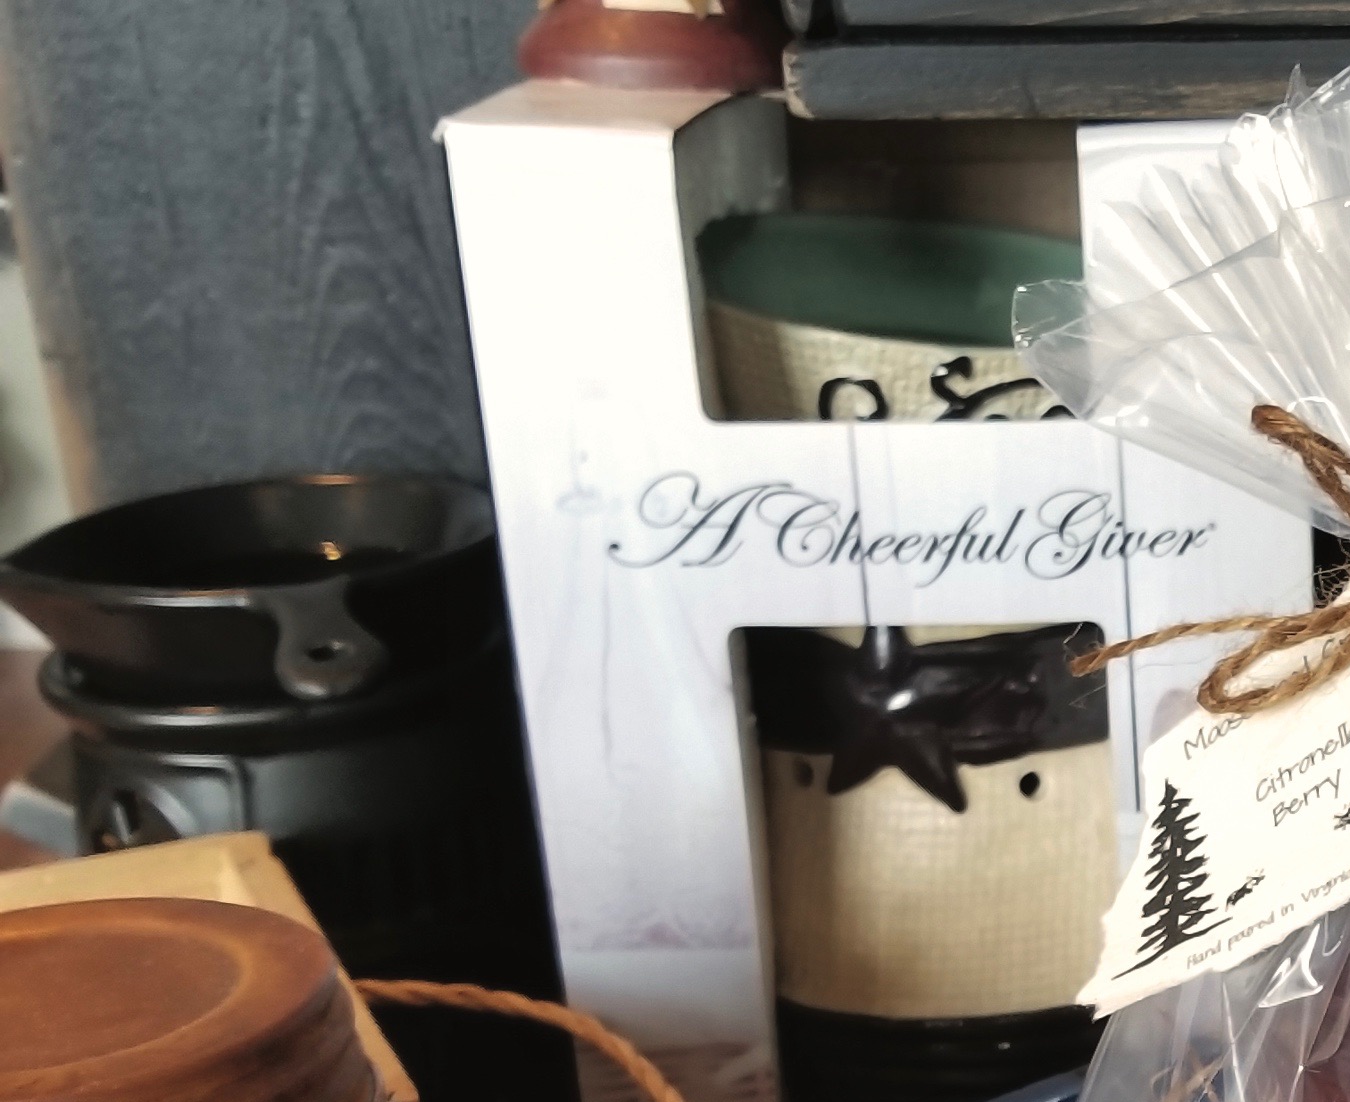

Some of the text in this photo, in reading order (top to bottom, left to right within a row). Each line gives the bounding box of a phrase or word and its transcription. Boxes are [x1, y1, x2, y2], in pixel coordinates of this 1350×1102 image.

[607, 470, 794, 568] A
[757, 487, 1026, 588] Cheerful
[1271, 769, 1342, 827] Berry
[1186, 939, 1223, 970] Hand
[1280, 903, 1295, 917] in
